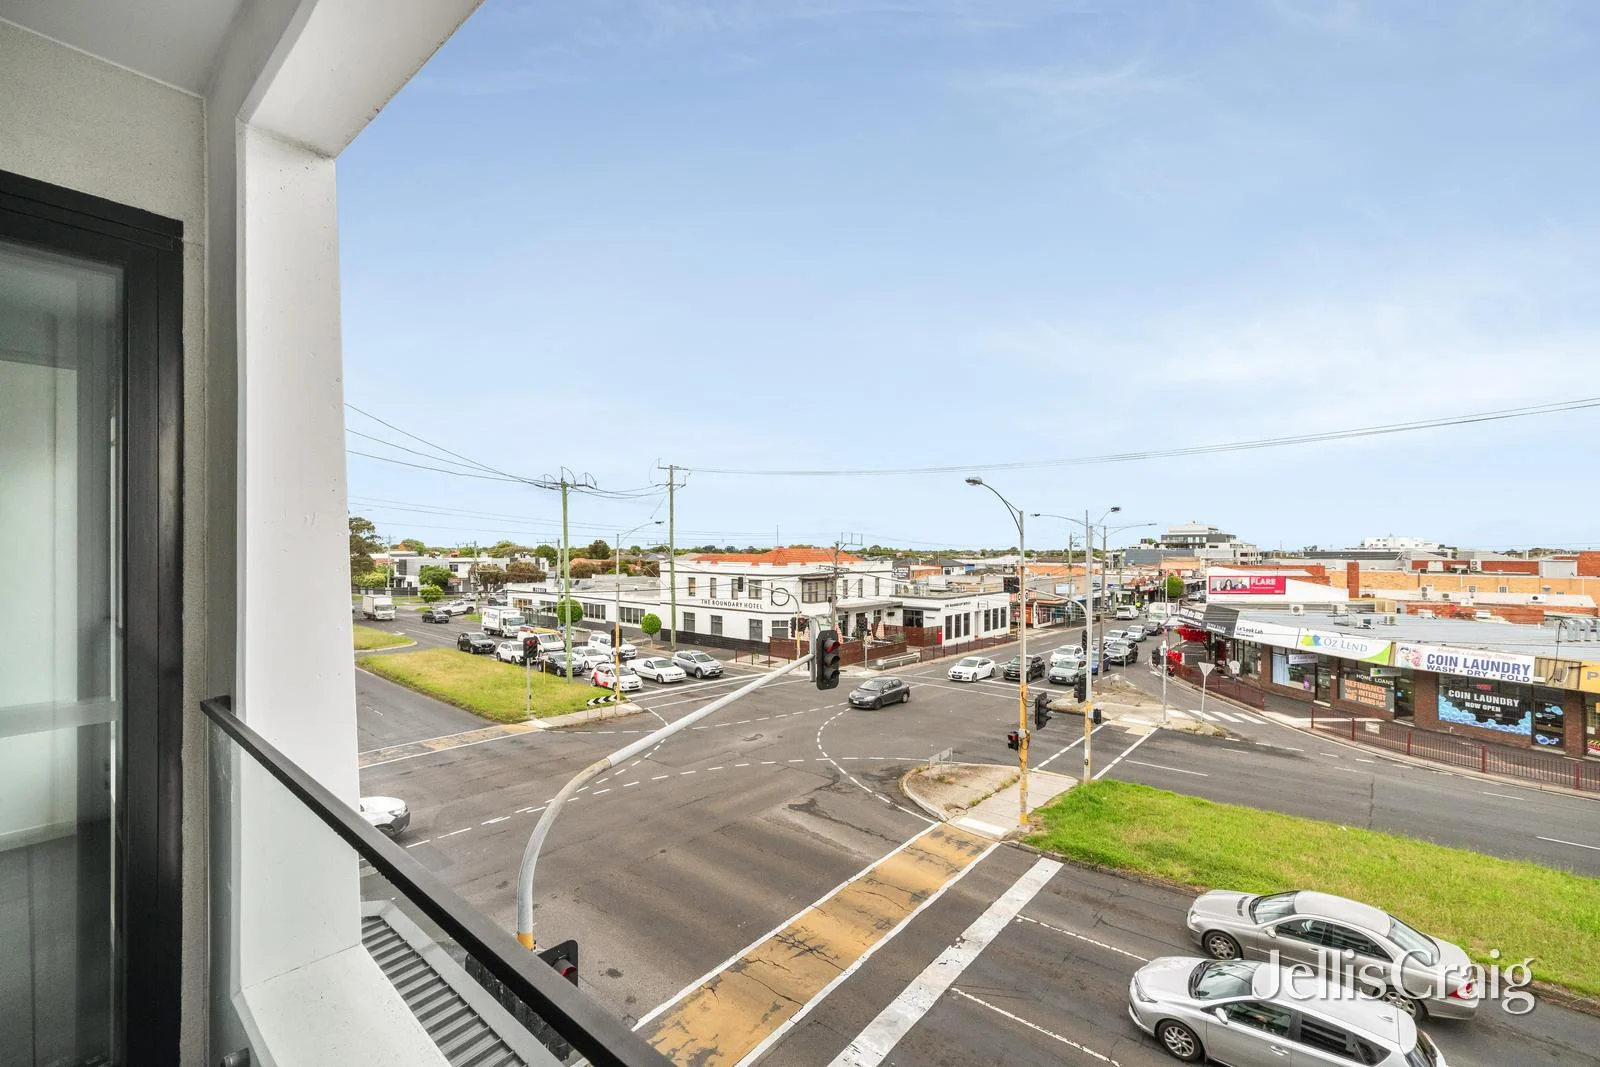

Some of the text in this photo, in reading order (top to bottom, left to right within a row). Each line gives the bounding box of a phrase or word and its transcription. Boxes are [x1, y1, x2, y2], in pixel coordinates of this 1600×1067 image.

[712, 600, 743, 608] BOUNDARY
[1324, 637, 1368, 652] OZ LEND
[1427, 653, 1459, 667] COIN
[1463, 657, 1531, 676] LAUNDRY
[1427, 664, 1530, 683] WASH DRY FOLD
[1375, 677, 1394, 686] LOANS
[1448, 689, 1520, 708] COIN LAUNDRY
[1465, 701, 1502, 712] NOW OPEN
